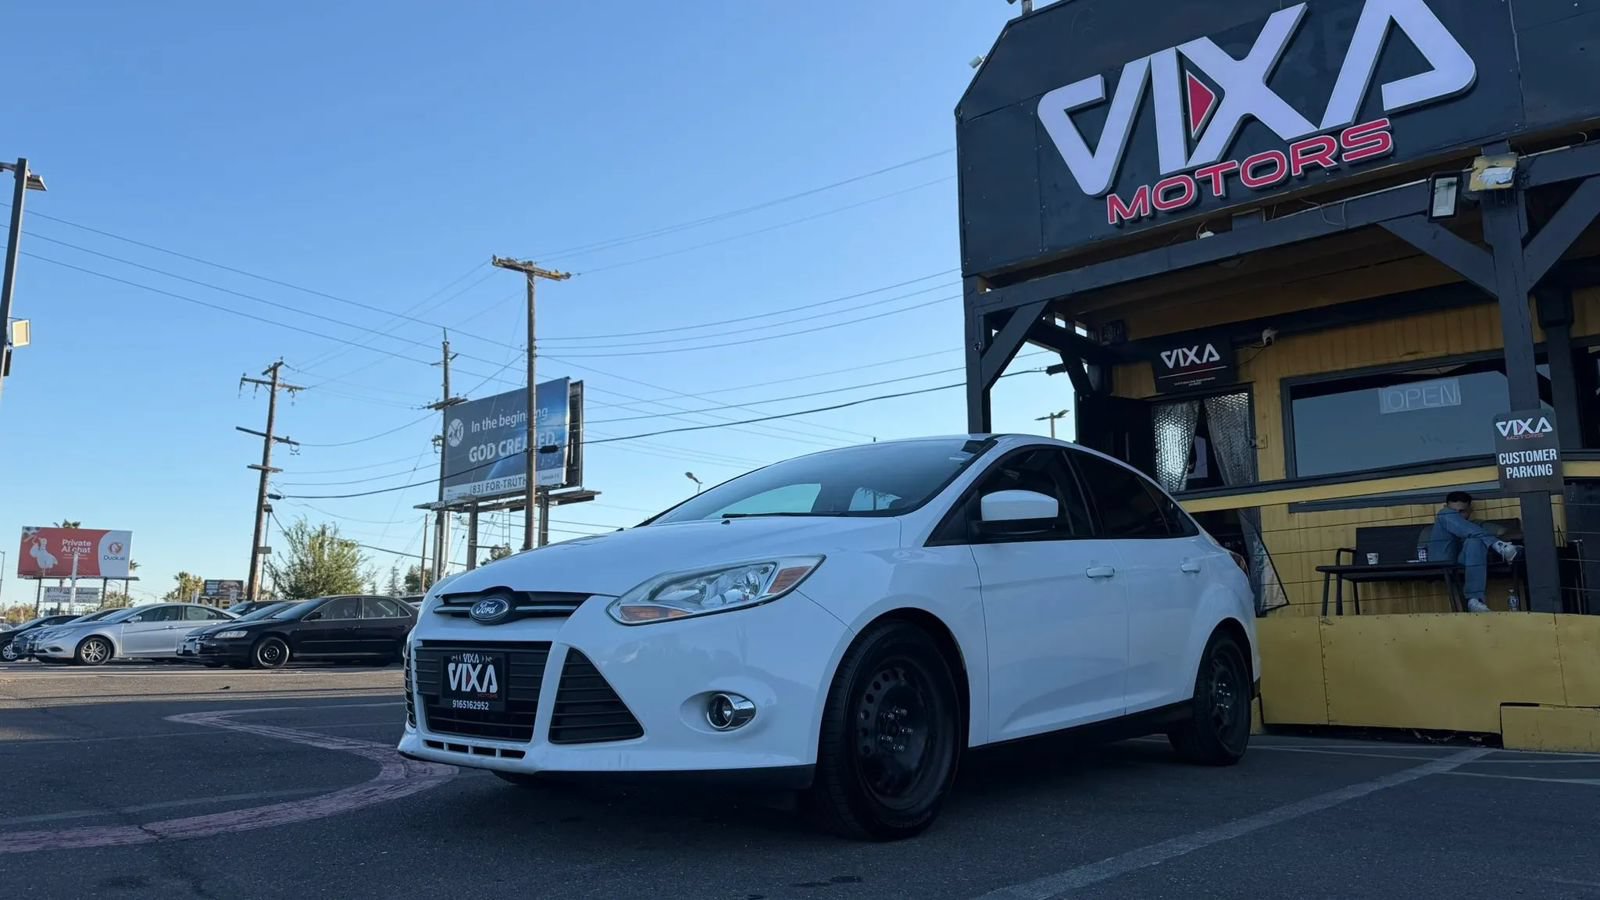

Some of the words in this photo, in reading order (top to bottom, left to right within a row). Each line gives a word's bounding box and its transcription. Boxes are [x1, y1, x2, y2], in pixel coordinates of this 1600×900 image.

[1037, 0, 1477, 196] VIXA
[1106, 117, 1393, 225] MOTORS
[1160, 343, 1220, 369] VIXA
[1387, 383, 1456, 410] OPEN
[471, 421, 480, 433] In
[482, 417, 497, 431] the
[1496, 416, 1553, 438] VIXA
[469, 442, 496, 463] GOD
[1499, 448, 1557, 465] CUSTOMER
[1506, 463, 1553, 479] PARKING
[61, 538, 92, 547] Private
[475, 601, 499, 615] Ford
[447, 662, 498, 693] VIXA
[452, 699, 489, 711] 9165162952
